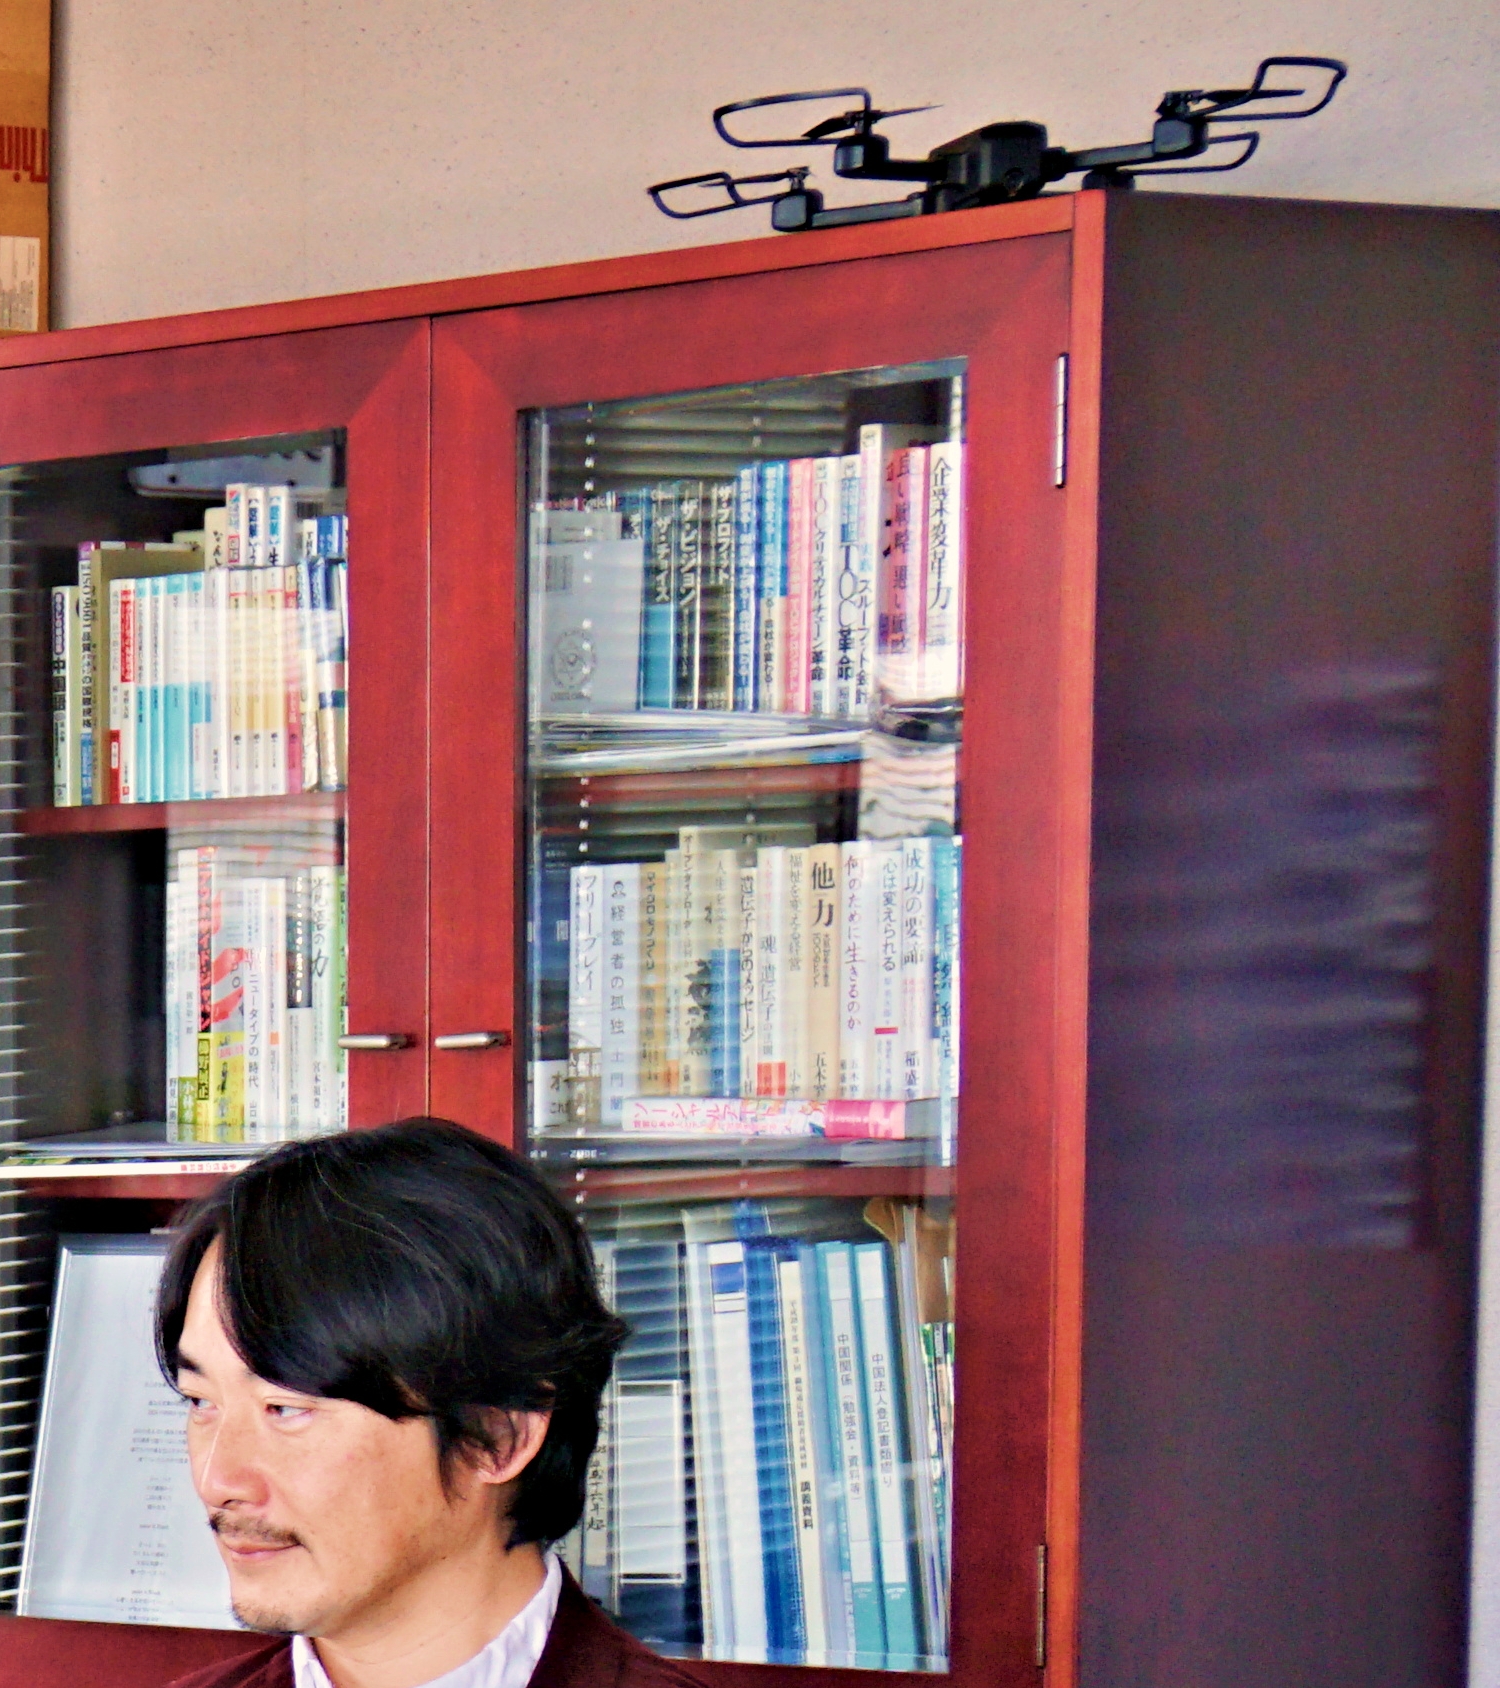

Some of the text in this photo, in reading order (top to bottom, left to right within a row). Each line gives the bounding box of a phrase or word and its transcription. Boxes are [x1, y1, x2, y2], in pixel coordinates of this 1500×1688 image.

[583, 875, 599, 991] フリープレイ
[811, 861, 836, 927] 他力
[844, 855, 865, 1030] 何のために生きるのか
[882, 858, 897, 973] 心は変えられる
[610, 905, 626, 1037] 経営者の孤独
[248, 974, 260, 1088] ニュータイプの時代
